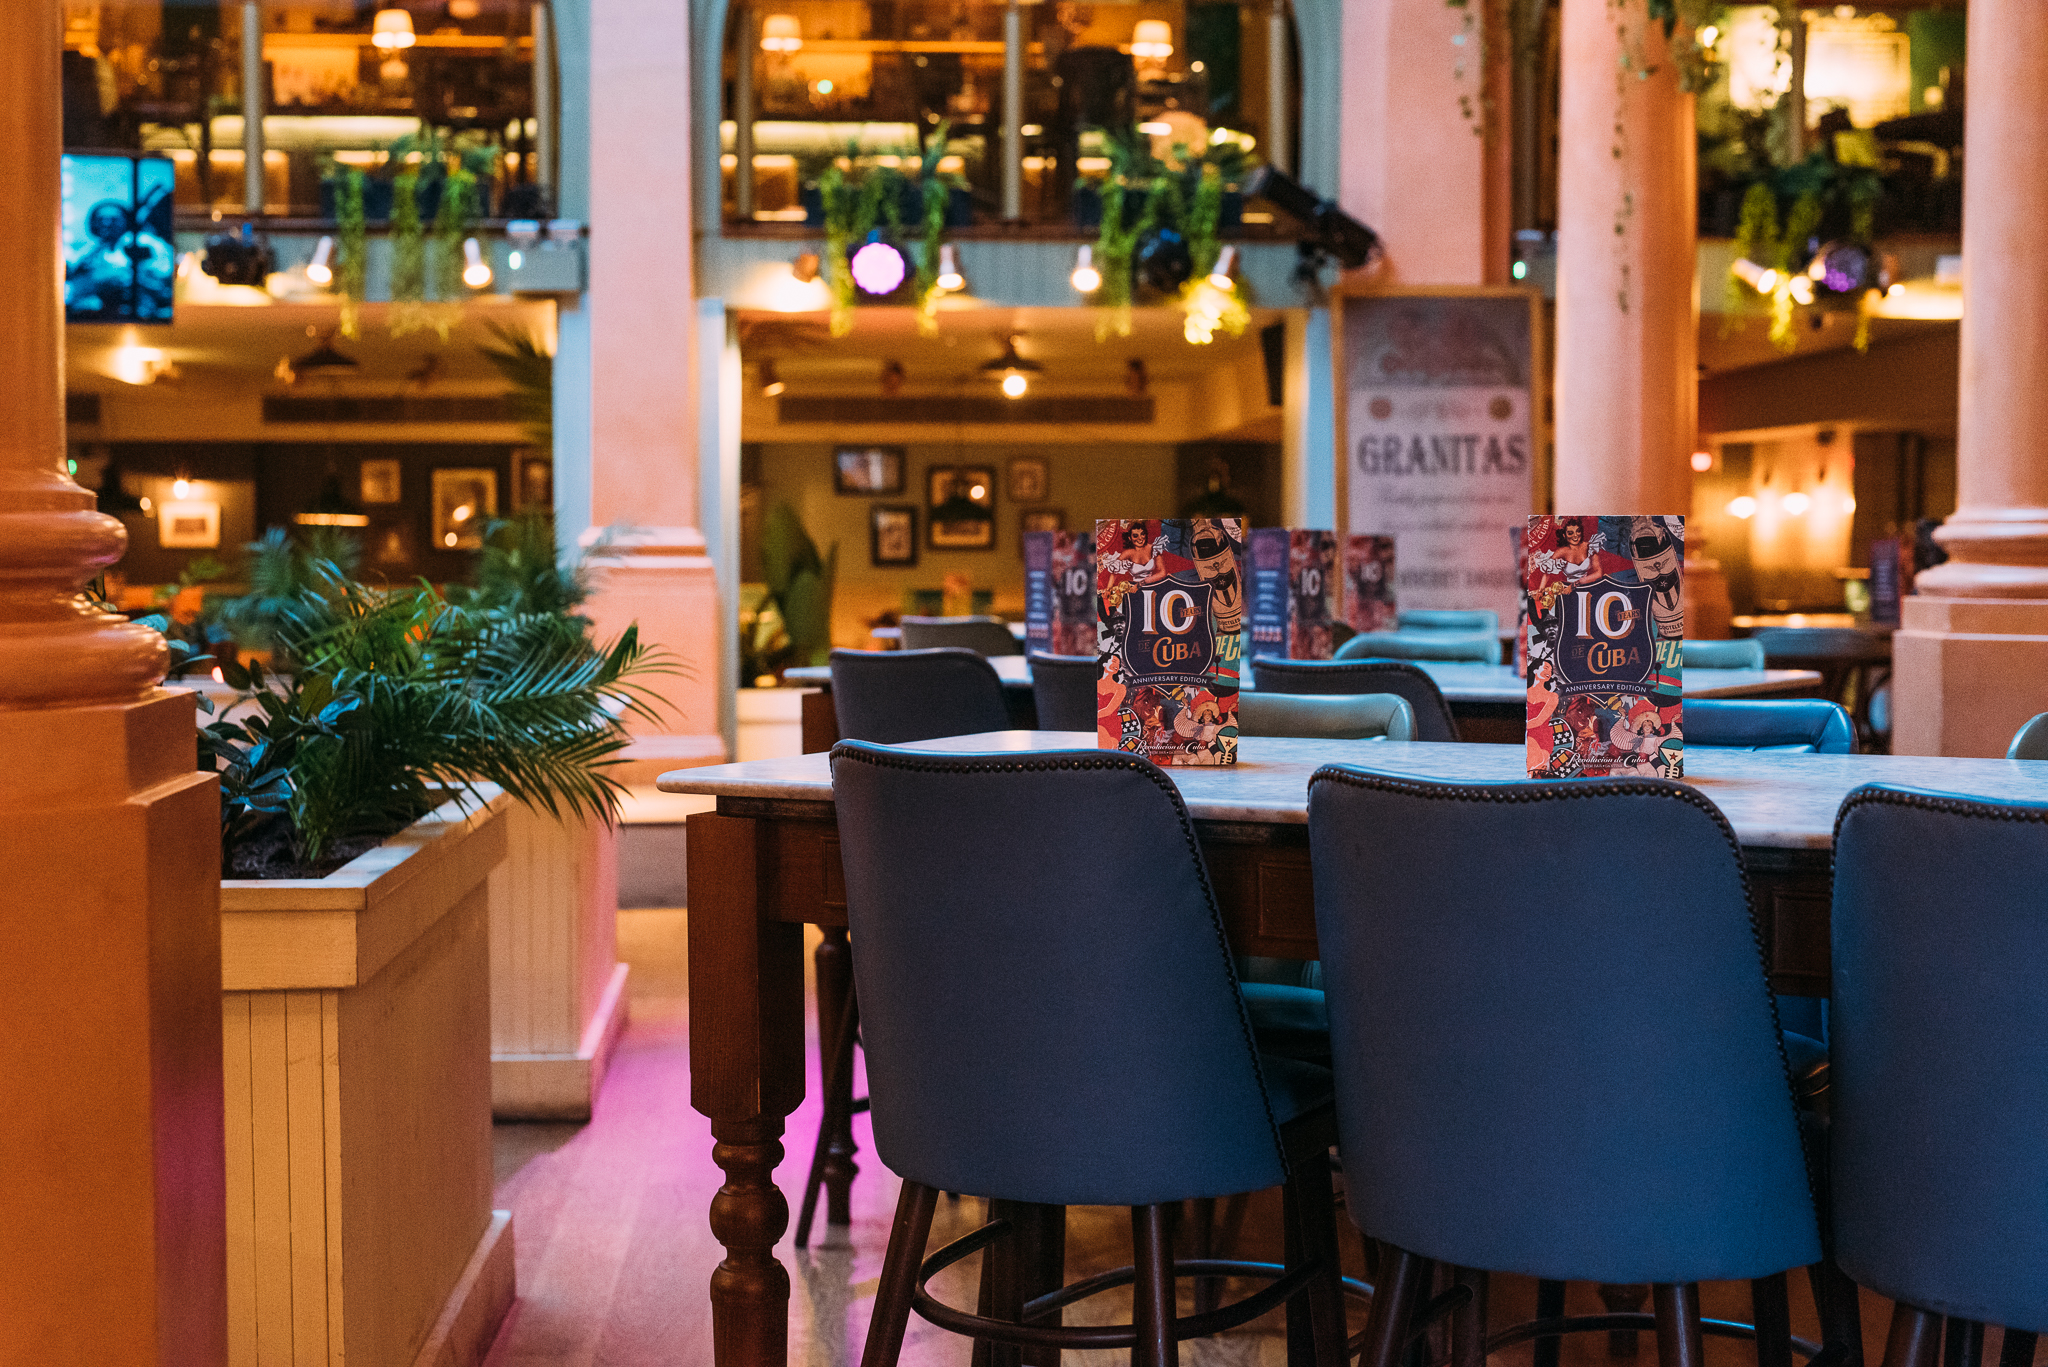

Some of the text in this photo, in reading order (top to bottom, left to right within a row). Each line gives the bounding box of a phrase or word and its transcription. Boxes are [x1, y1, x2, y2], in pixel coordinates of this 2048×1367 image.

[1357, 433, 1526, 476] GRANITAS
[1537, 519, 1550, 539] CUBA
[1141, 589, 1197, 635] 10
[1575, 591, 1640, 639] 10 YEARS
[1132, 675, 1208, 685] ANNIVERSARY EDITION
[1565, 683, 1647, 693] ANNIVERSARY EDITION
[1185, 741, 1205, 755] Cuba
[1623, 754, 1647, 767] Cuba
